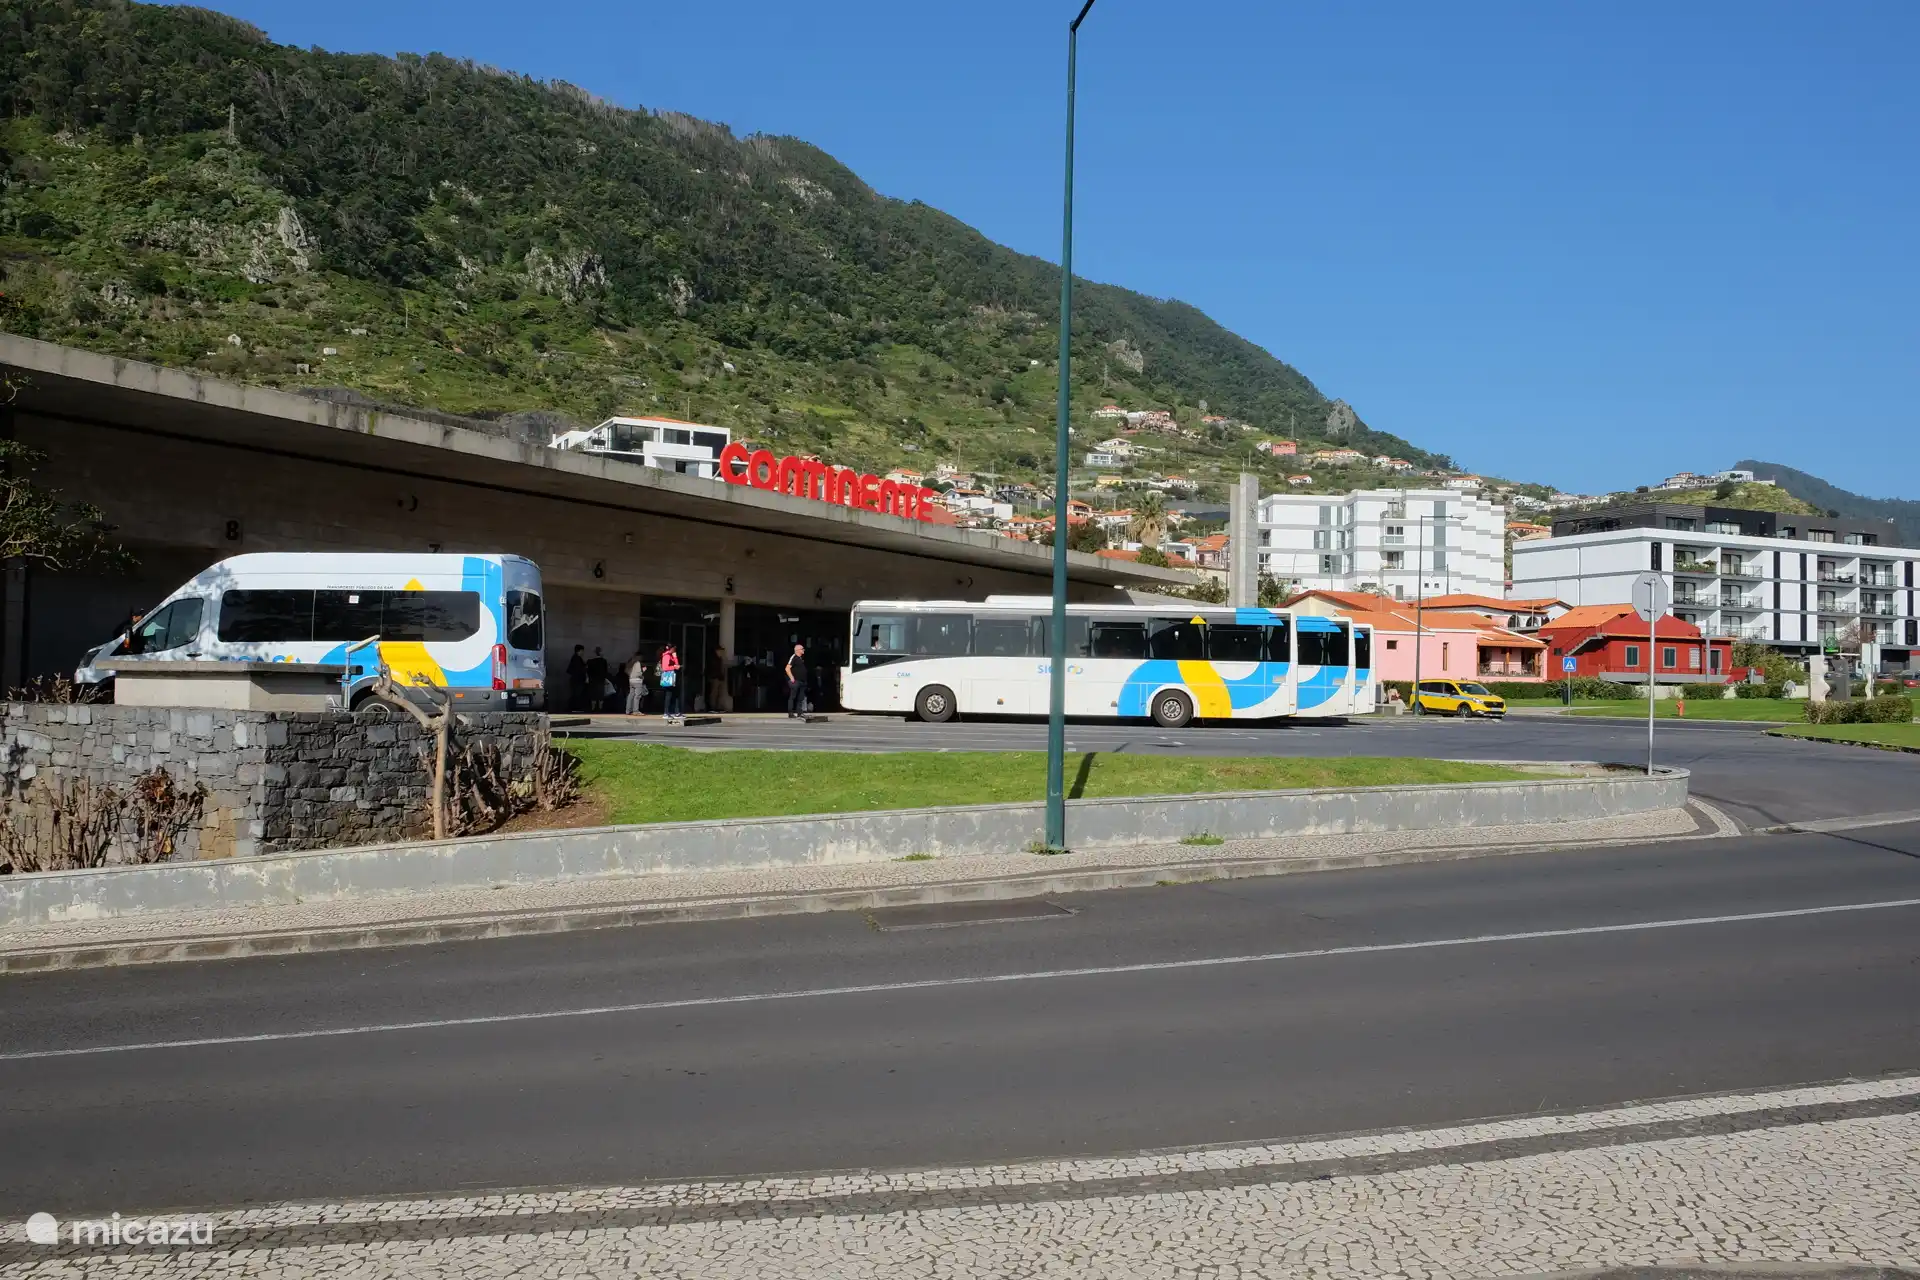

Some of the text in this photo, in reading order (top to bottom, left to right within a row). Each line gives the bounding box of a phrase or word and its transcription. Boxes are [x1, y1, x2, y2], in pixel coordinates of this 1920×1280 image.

[720, 441, 933, 522] CONTINENTE
[226, 520, 239, 541] 8
[594, 561, 604, 579] 6
[725, 577, 733, 592] 5
[815, 587, 823, 601] 4
